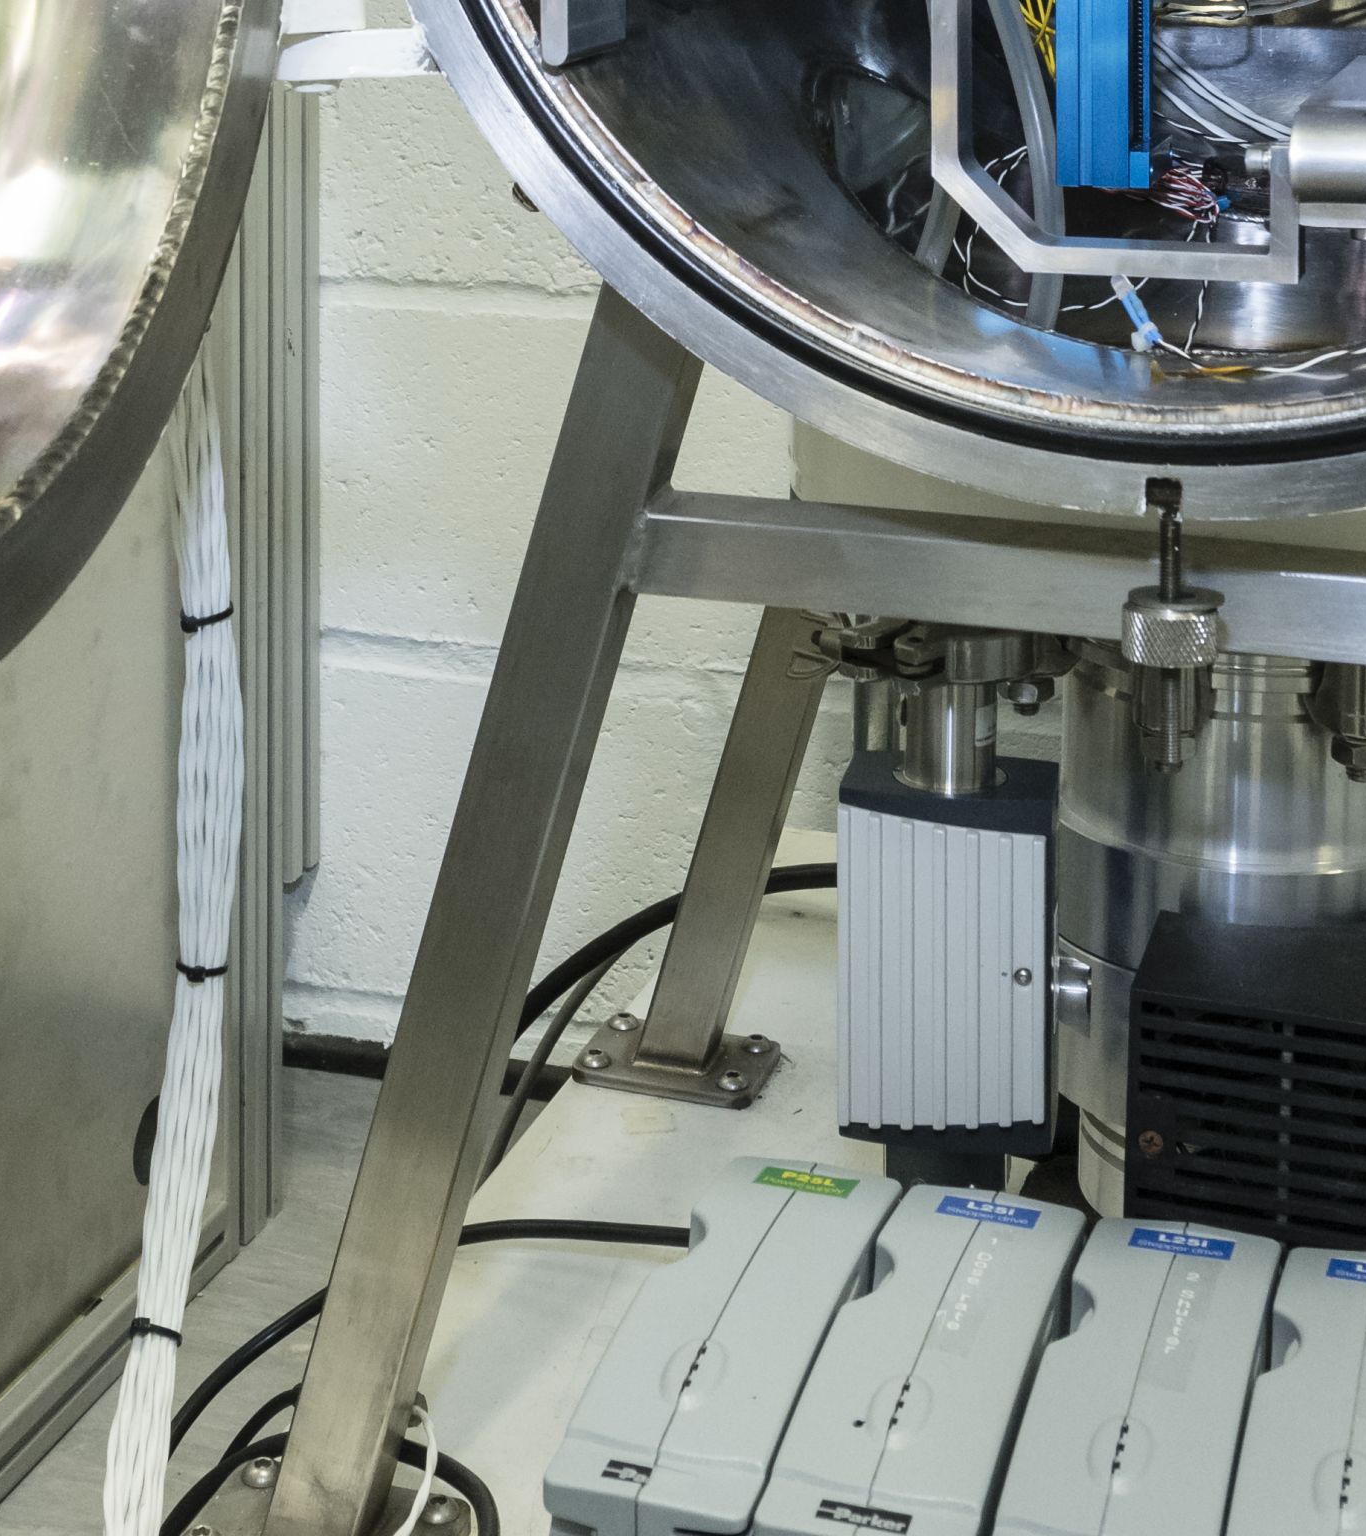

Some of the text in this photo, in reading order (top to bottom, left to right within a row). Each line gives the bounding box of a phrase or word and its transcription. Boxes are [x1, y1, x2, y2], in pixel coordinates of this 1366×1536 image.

[781, 1170, 835, 1187] P25L
[997, 1214, 1029, 1226] drive
[1190, 1246, 1224, 1258] drive
[1164, 1289, 1195, 1355] Shutter
[833, 1506, 907, 1532] Parker
